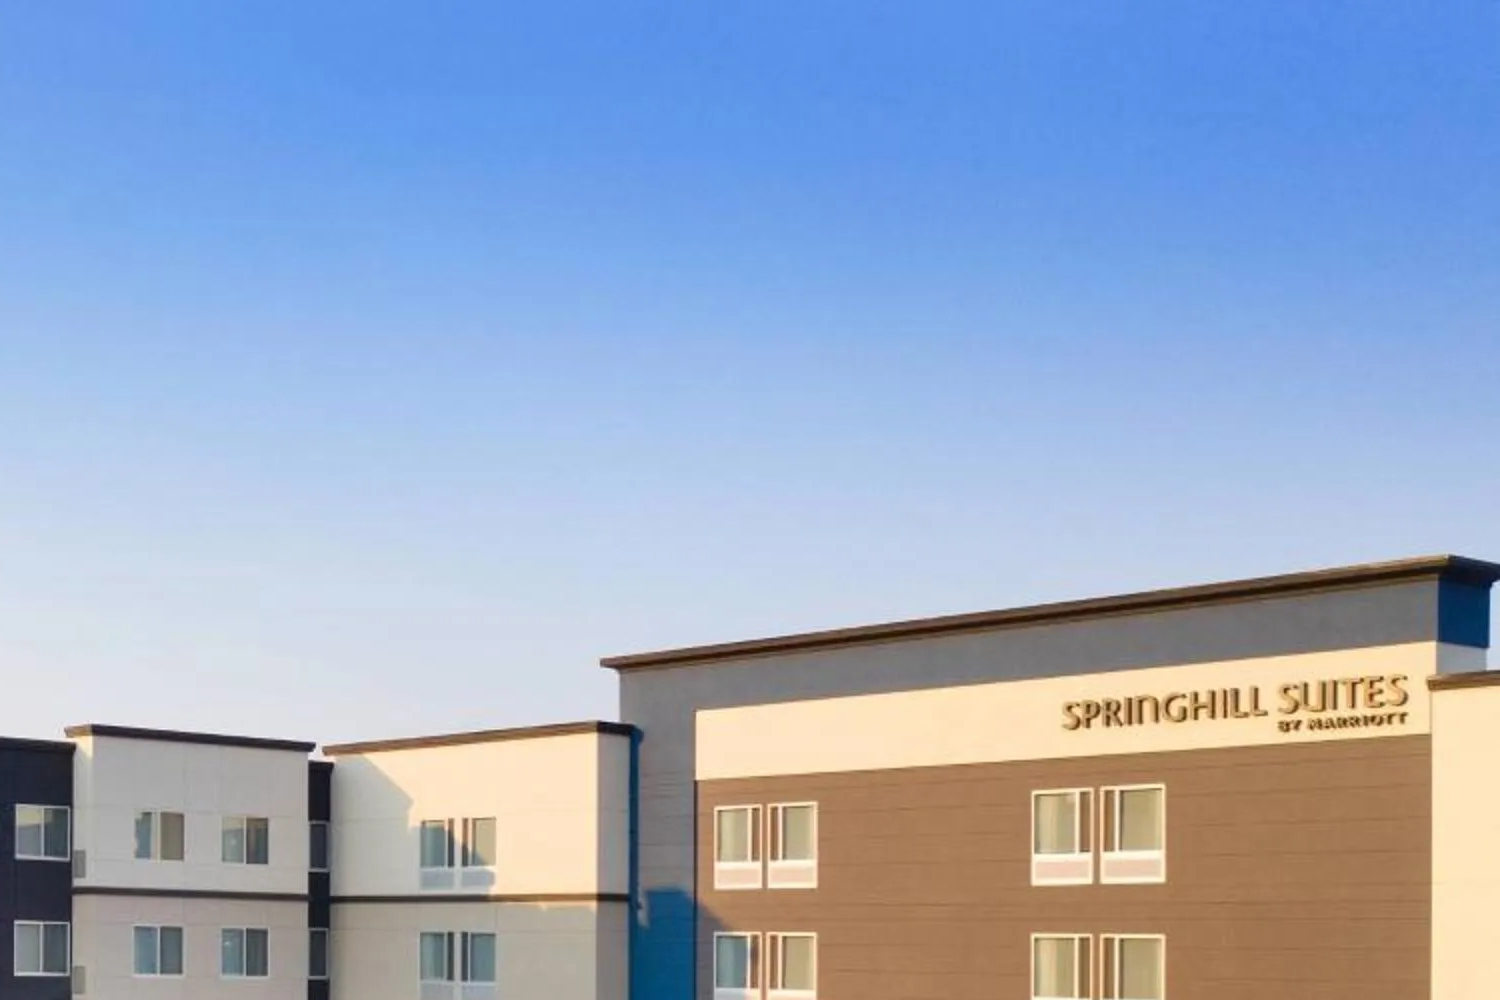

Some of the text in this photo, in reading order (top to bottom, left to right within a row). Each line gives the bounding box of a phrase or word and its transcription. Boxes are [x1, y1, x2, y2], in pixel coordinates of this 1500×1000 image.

[1062, 674, 1409, 730] SPRINGHILL SUITES
[1277, 711, 1408, 732] BY MARRIOTT
